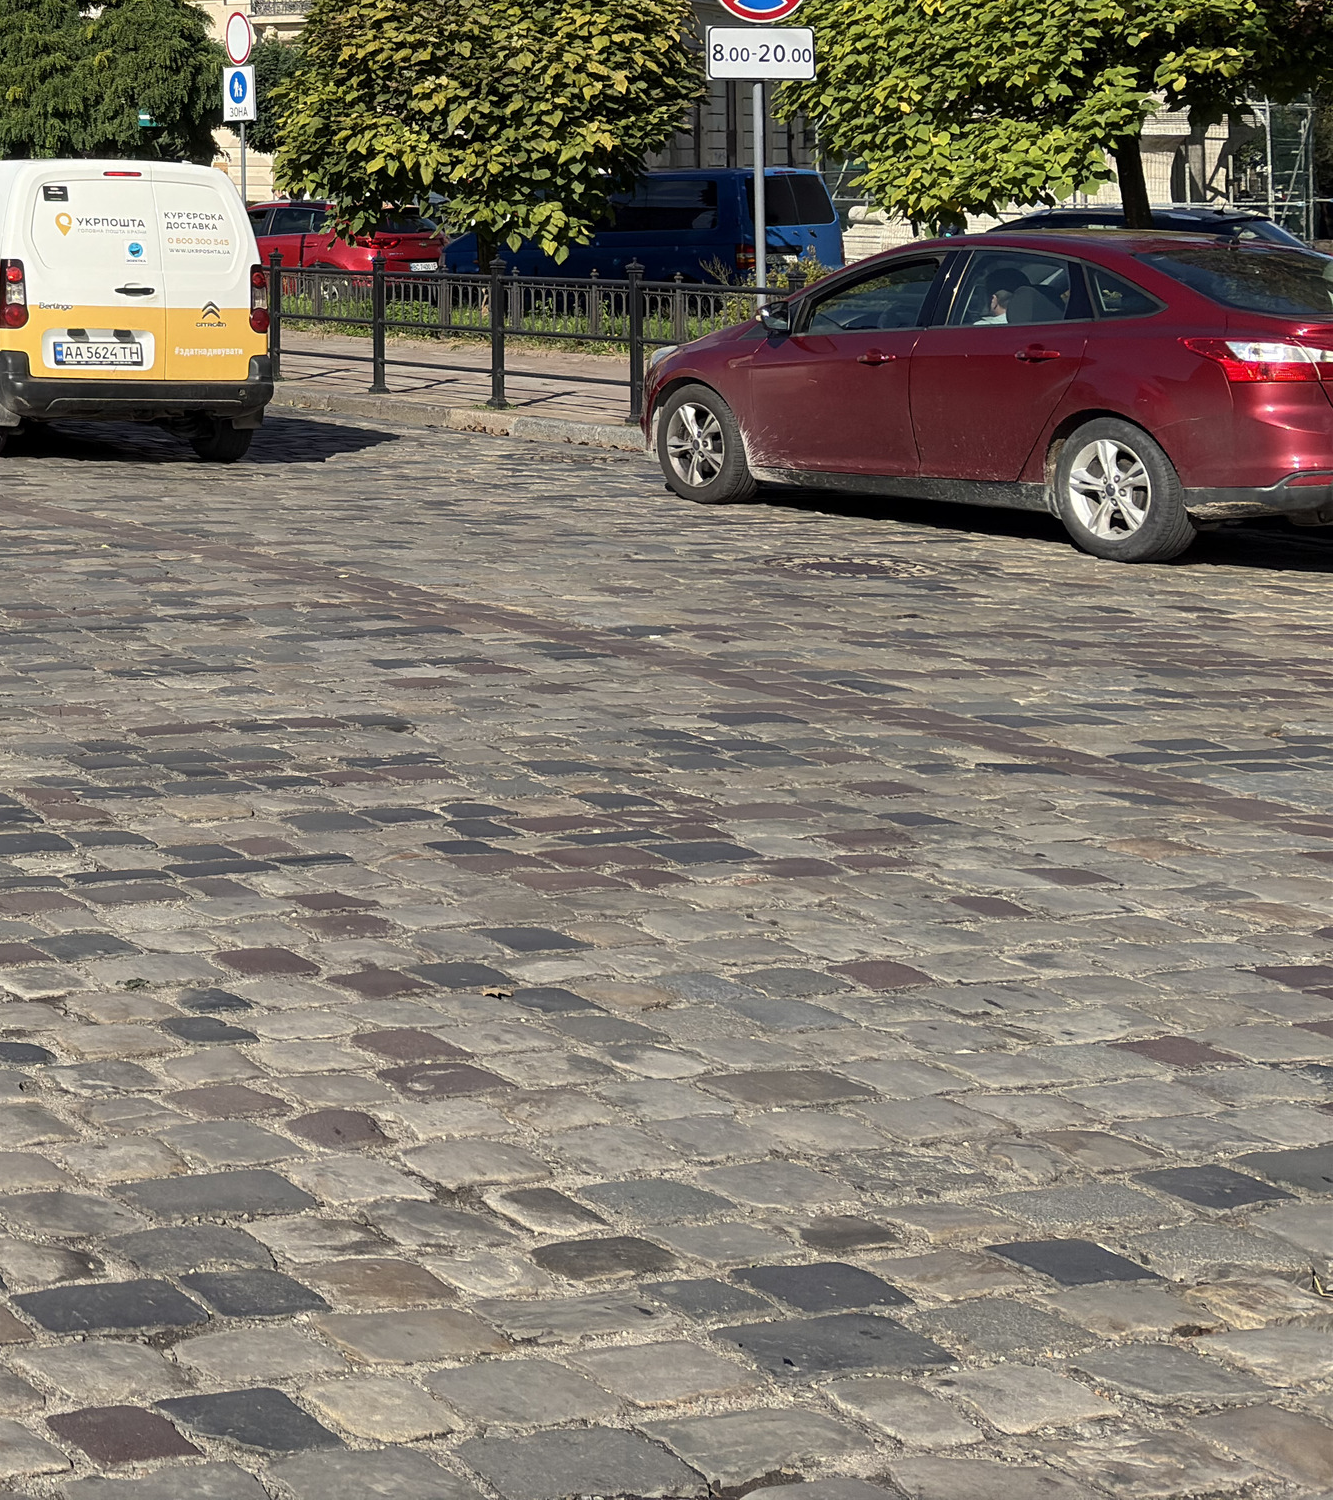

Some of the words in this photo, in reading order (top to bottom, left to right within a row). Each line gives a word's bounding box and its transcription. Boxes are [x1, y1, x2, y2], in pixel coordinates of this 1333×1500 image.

[712, 43, 812, 63] 8.00-20.00
[230, 107, 248, 117] ЗОНА
[76, 216, 146, 228] УКРПОШТА
[165, 221, 219, 231] ДОСТАВКА
[175, 237, 193, 245] 800
[195, 238, 212, 246] 300
[38, 302, 74, 310] Berlingo
[64, 347, 83, 360] AA
[86, 347, 118, 360] 5624
[121, 347, 141, 360] TH
